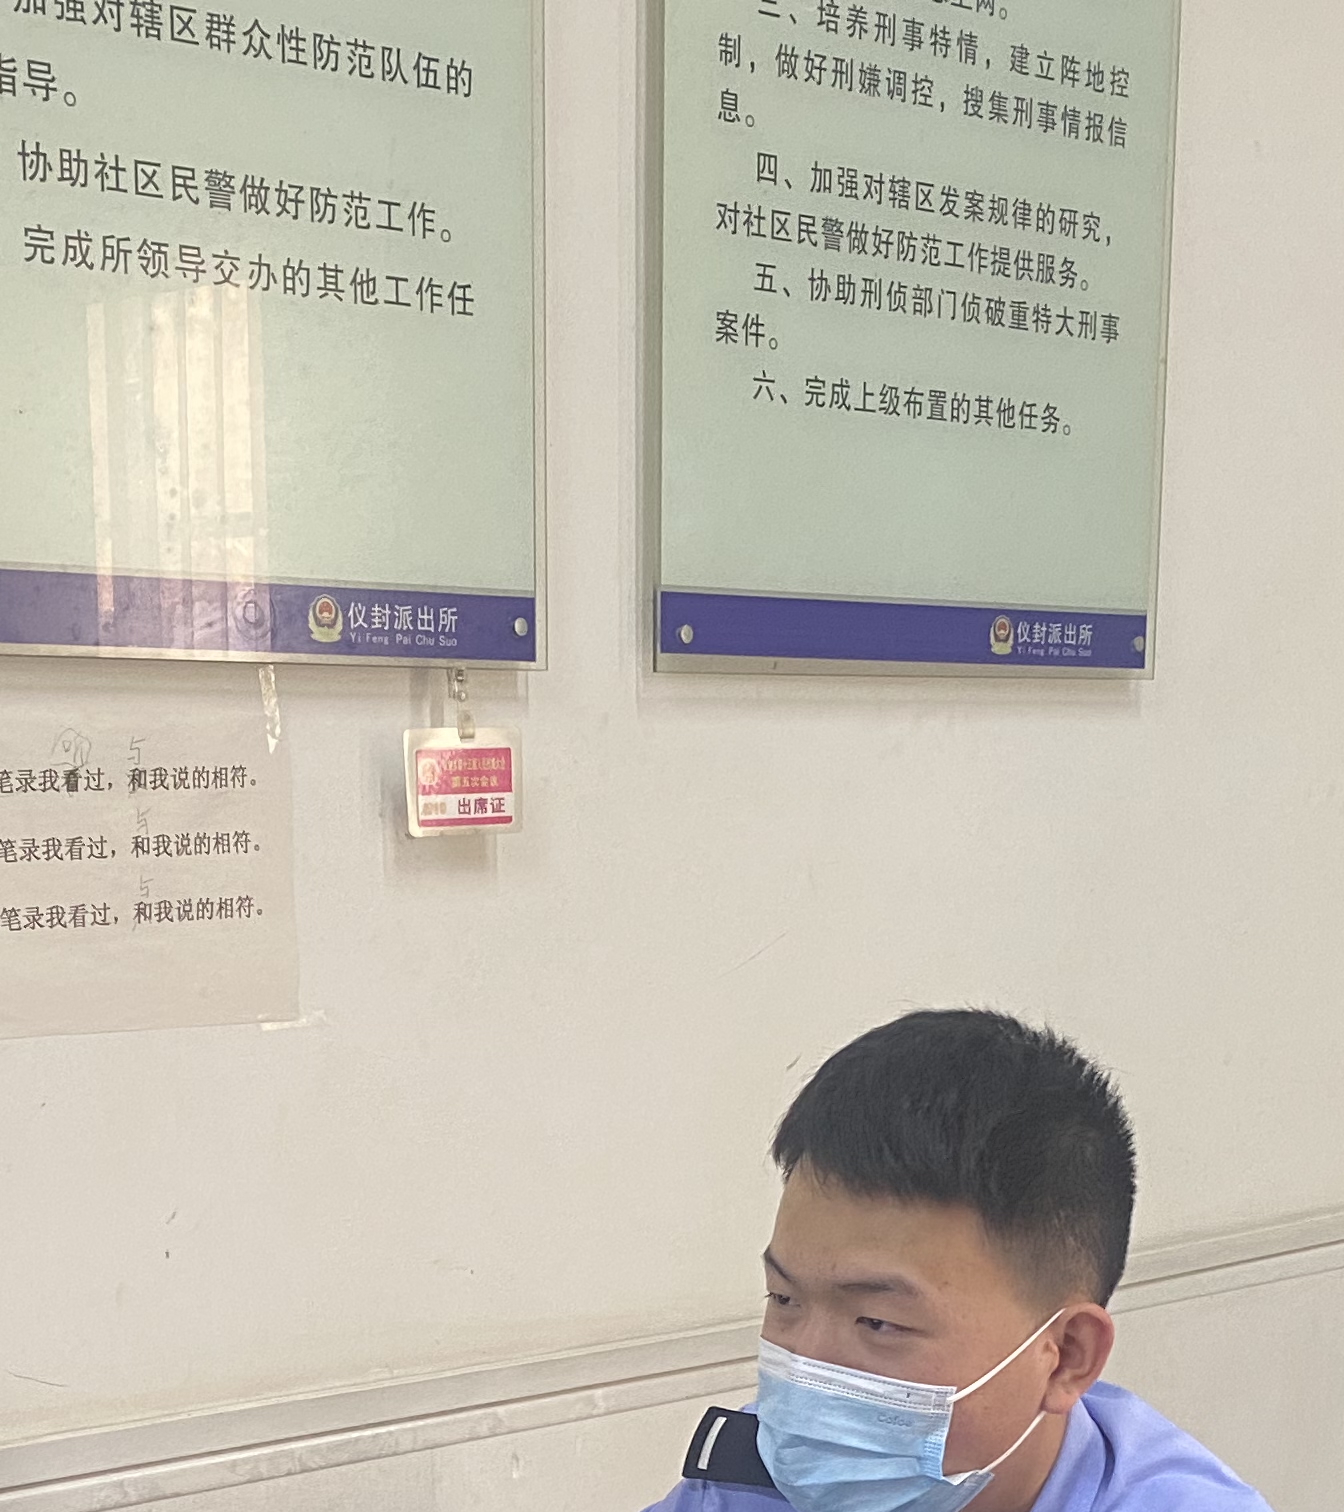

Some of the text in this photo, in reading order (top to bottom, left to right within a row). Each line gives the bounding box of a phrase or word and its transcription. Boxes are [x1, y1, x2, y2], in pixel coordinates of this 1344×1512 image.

[718, 32, 1128, 148] 制，做好刑嫌调控，搜集刑事情报信
[718, 88, 755, 128] 息。
[757, 151, 1113, 247] 四、加强对辖区发案规律的研究，
[715, 202, 1090, 292] 对社区民警做好防范工作提供服务。
[754, 262, 1121, 344] 五、协助刑侦部门侦破重特大刑事
[714, 310, 779, 351] 案件。
[752, 369, 1073, 436] 六、完成上级布置的其他任务。
[347, 602, 458, 633] 仪封派出所
[1016, 621, 1094, 646] 仪封派出所
[366, 632, 389, 645] Feng
[395, 634, 412, 645] Pai
[415, 635, 435, 646] Chu
[439, 636, 458, 647] Suo
[458, 796, 506, 815] 出席证
